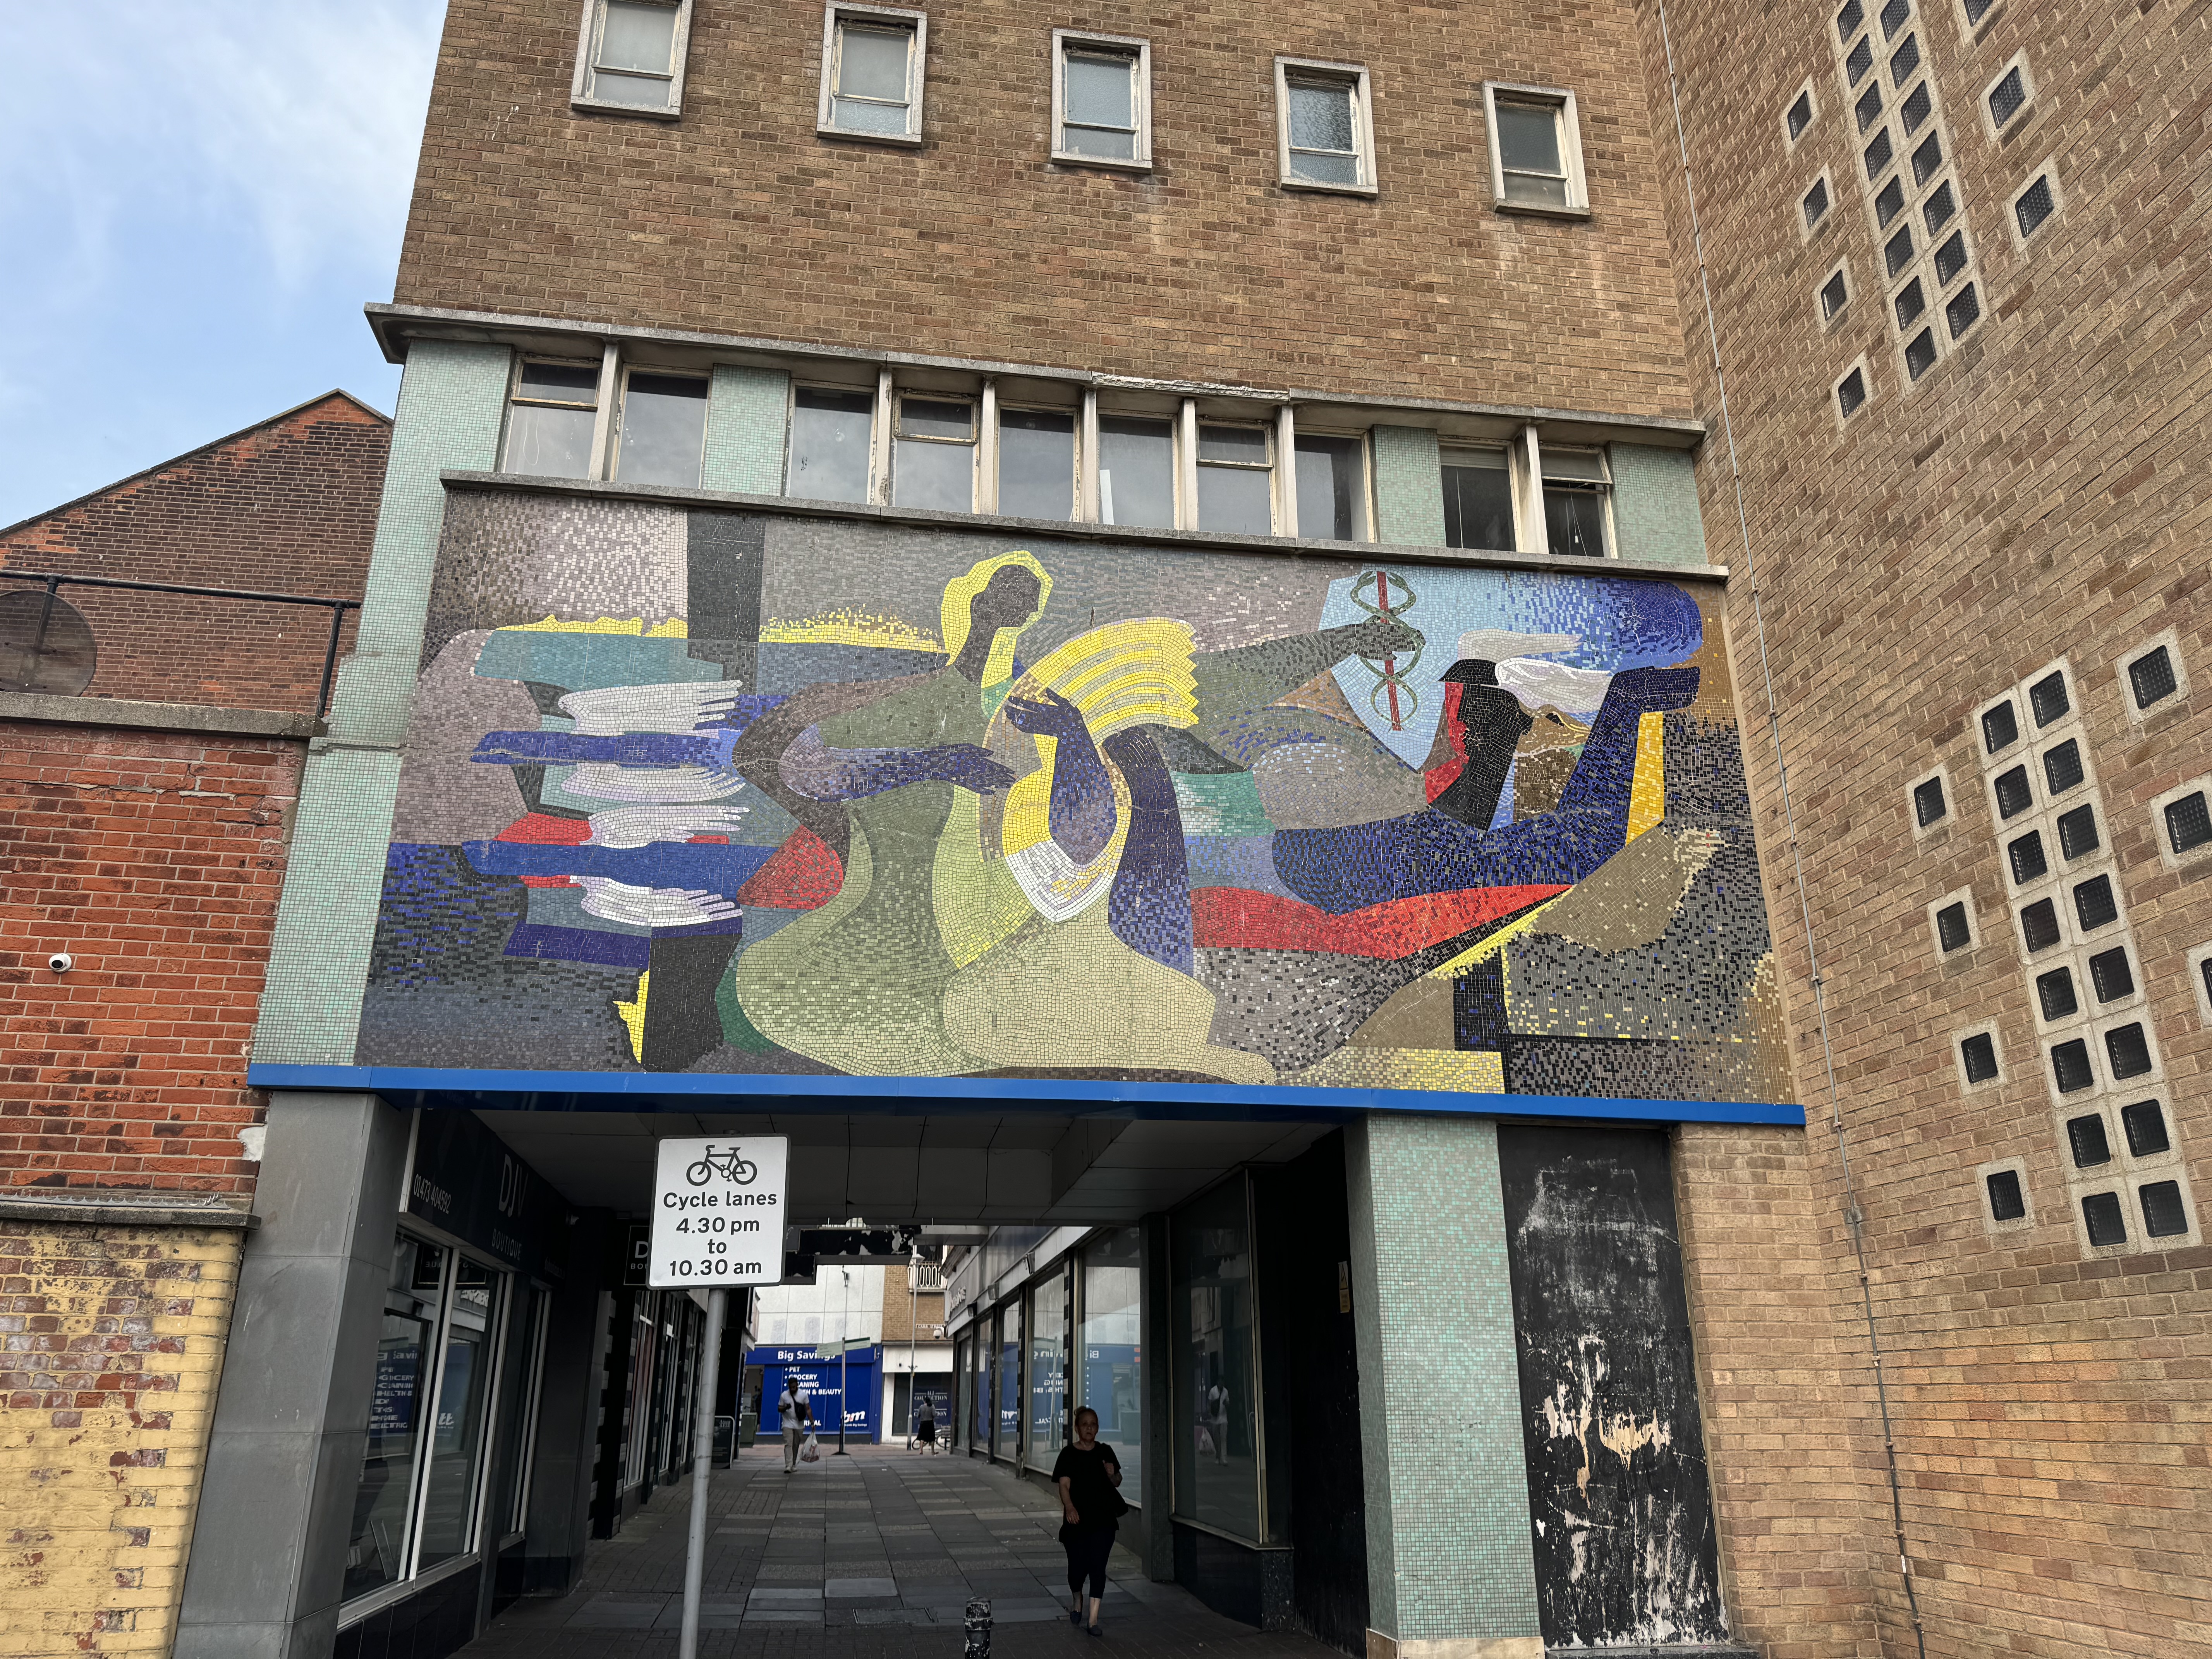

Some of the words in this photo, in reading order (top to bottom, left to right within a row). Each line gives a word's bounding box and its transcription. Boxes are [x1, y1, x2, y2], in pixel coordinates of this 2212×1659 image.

[414, 1173, 431, 1202] 01473
[431, 1185, 451, 1214] 404592
[663, 1192, 718, 1211] Cycle
[726, 1191, 777, 1206] lanes
[676, 1217, 725, 1234] 4.30
[730, 1220, 759, 1235] pm
[492, 1228, 522, 1261] BOUTIQUE
[707, 1238, 727, 1254] to
[670, 1259, 728, 1276] 10.30
[733, 1262, 761, 1274] am
[778, 1350, 794, 1362] Big
